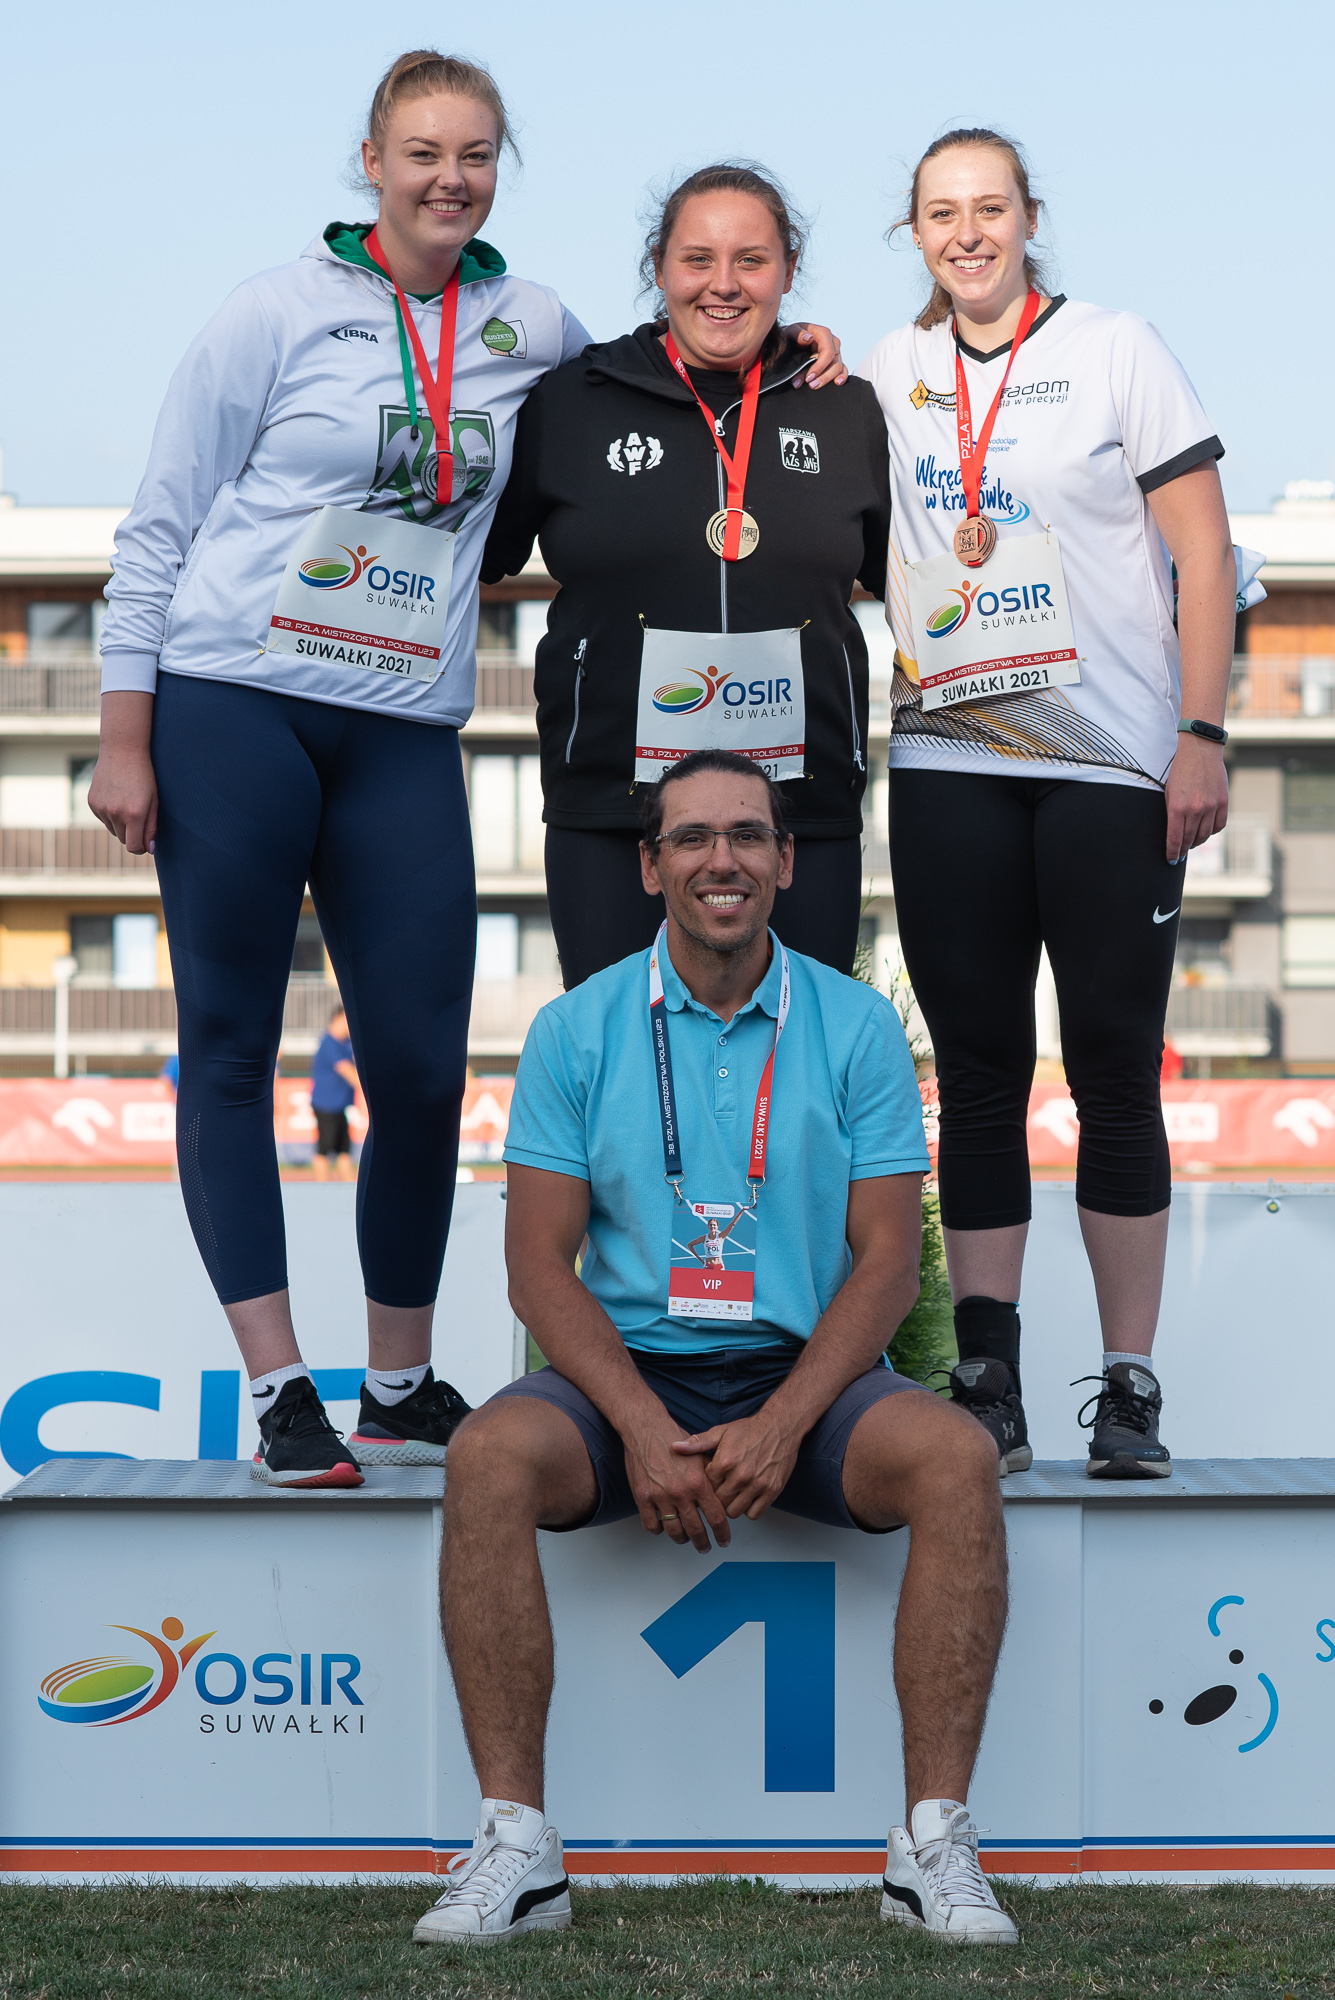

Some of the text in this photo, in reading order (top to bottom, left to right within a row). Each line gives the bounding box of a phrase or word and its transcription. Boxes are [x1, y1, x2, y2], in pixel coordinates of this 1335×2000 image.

[1001, 381, 1069, 398] adom
[1026, 393, 1068, 405] precyzji
[778, 427, 816, 437] WARSZAWA
[960, 422, 971, 459] PZLA
[475, 455, 489, 465] 1946
[785, 454, 817, 470] AZS AWF
[925, 477, 1014, 514] w kraówkę
[367, 566, 436, 602] OSIR
[366, 593, 435, 615] SUWAŁKI
[977, 583, 1054, 616] OSIR
[981, 610, 1057, 630] SUWAŁKI
[277, 619, 435, 656] 38. PZLA MISTRZOSTWA POLSKI U23
[295, 639, 412, 675] SUWAŁKI 2021
[937, 673, 954, 682] PZLA
[954, 660, 1014, 677] MISTRZOSTWA
[1016, 655, 1049, 664] POLSKI
[1050, 652, 1071, 660] U23
[722, 678, 792, 707] OSIR
[942, 669, 1049, 703] SUWAŁKI 2021
[724, 706, 793, 720] SUWAŁKI
[641, 749, 656, 757] 38.
[658, 750, 681, 758] PZLA
[752, 749, 781, 758] POLSKI
[782, 747, 799, 755] U23
[763, 764, 778, 778] 21
[655, 1018, 663, 1035] U23
[657, 1035, 666, 1062] POLSKI
[660, 1064, 671, 1118] MISTRZOSTWA
[754, 1096, 768, 1159] SUWAŁKI 2021
[703, 1279, 722, 1290] VIP
[195, 1653, 364, 1705] OSIR
[640, 1562, 835, 1792] 1
[200, 1715, 364, 1734] SUWAŁKI
